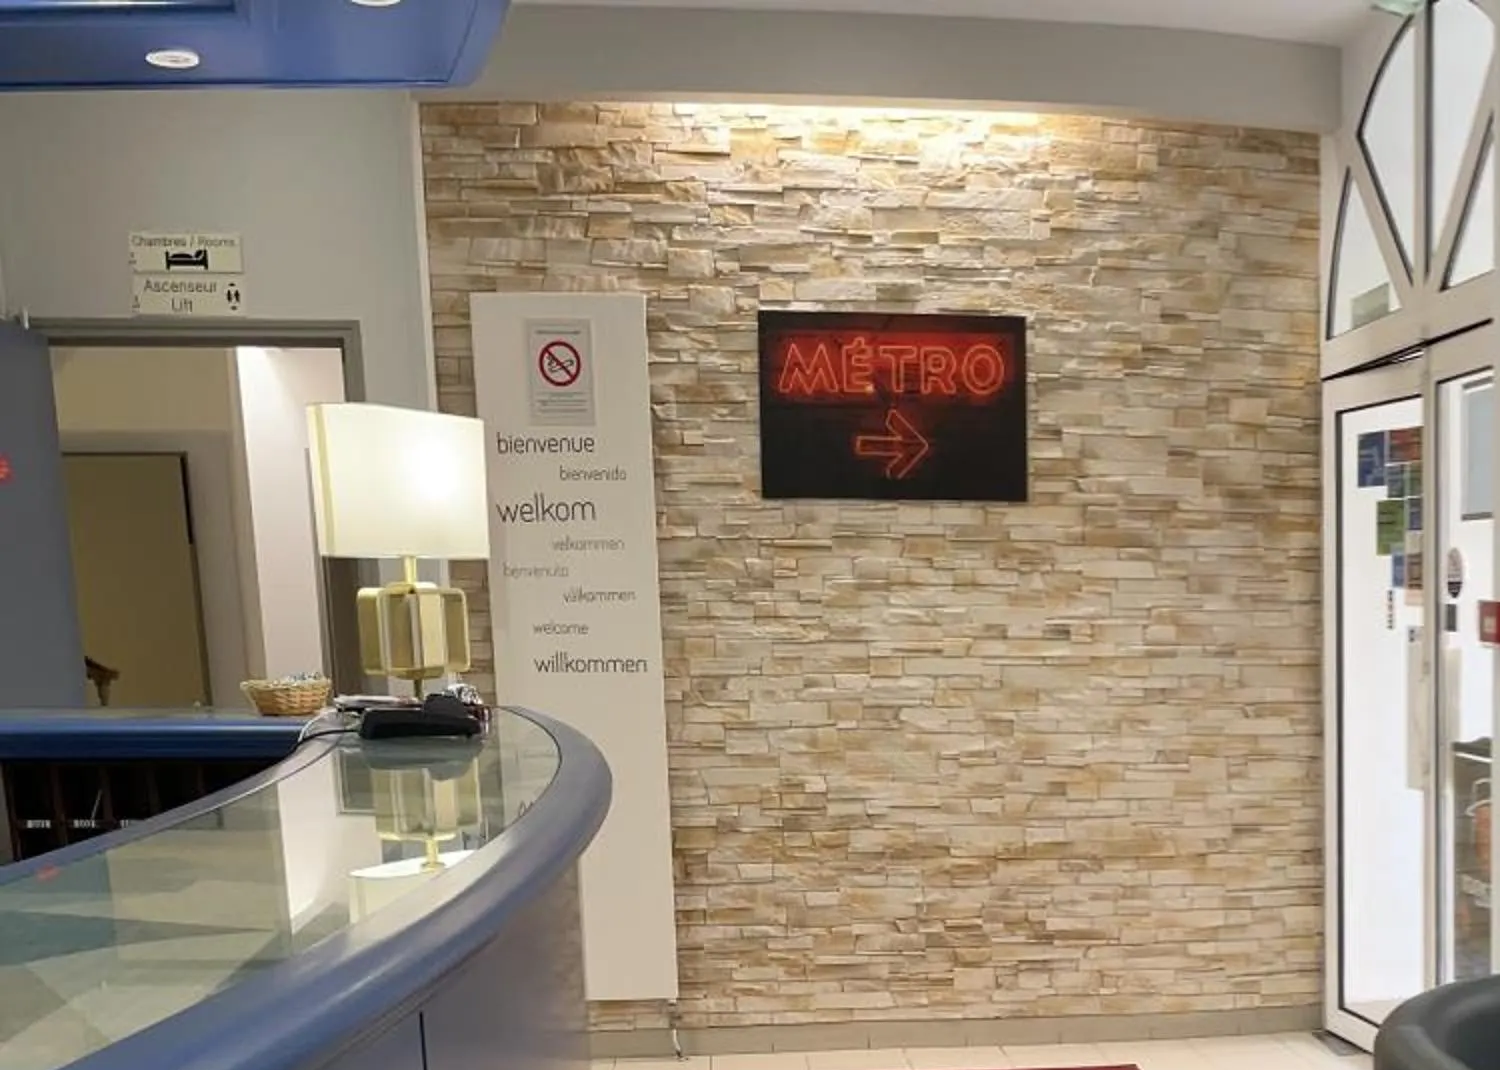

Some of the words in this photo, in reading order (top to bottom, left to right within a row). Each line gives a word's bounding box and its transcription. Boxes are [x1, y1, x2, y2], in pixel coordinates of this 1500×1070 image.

[143, 280, 217, 293] Ascenseur
[779, 336, 1005, 395] MÉTRO
[496, 431, 595, 454] bienvenue
[560, 464, 627, 481] bienvenido
[496, 492, 596, 523] welkom
[533, 620, 589, 635] welcome
[534, 652, 648, 673] willkommen
